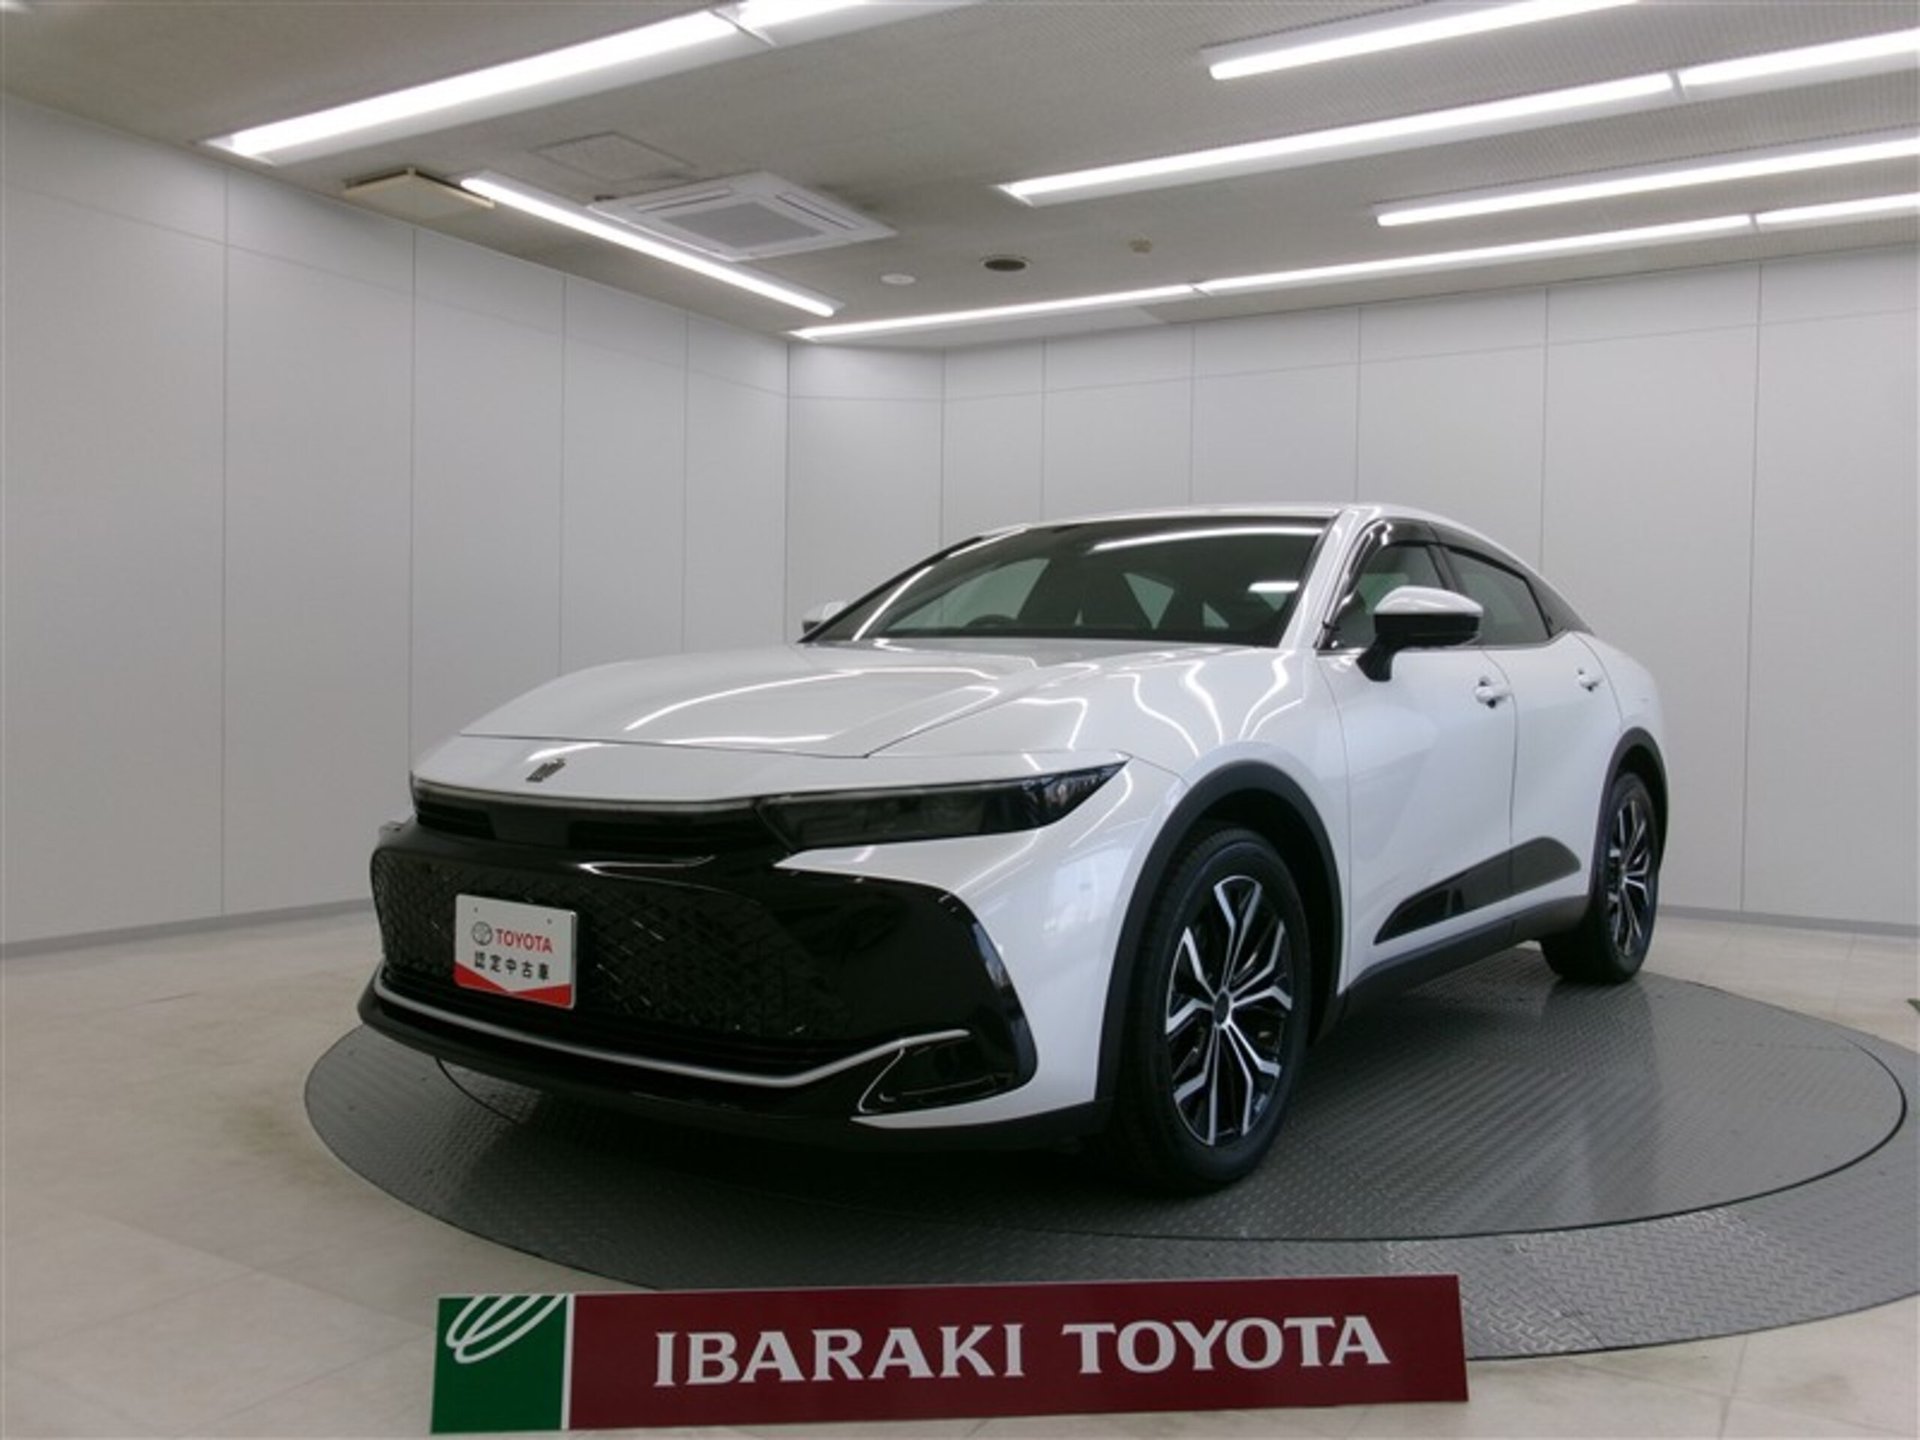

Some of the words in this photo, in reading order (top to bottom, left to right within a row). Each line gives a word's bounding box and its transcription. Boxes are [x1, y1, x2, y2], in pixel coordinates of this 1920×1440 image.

[495, 928, 553, 954] TOYOTA
[474, 950, 551, 982] 認定中古車
[655, 1324, 1024, 1387] IBARAKI
[1062, 1316, 1390, 1374] TOYOTA
